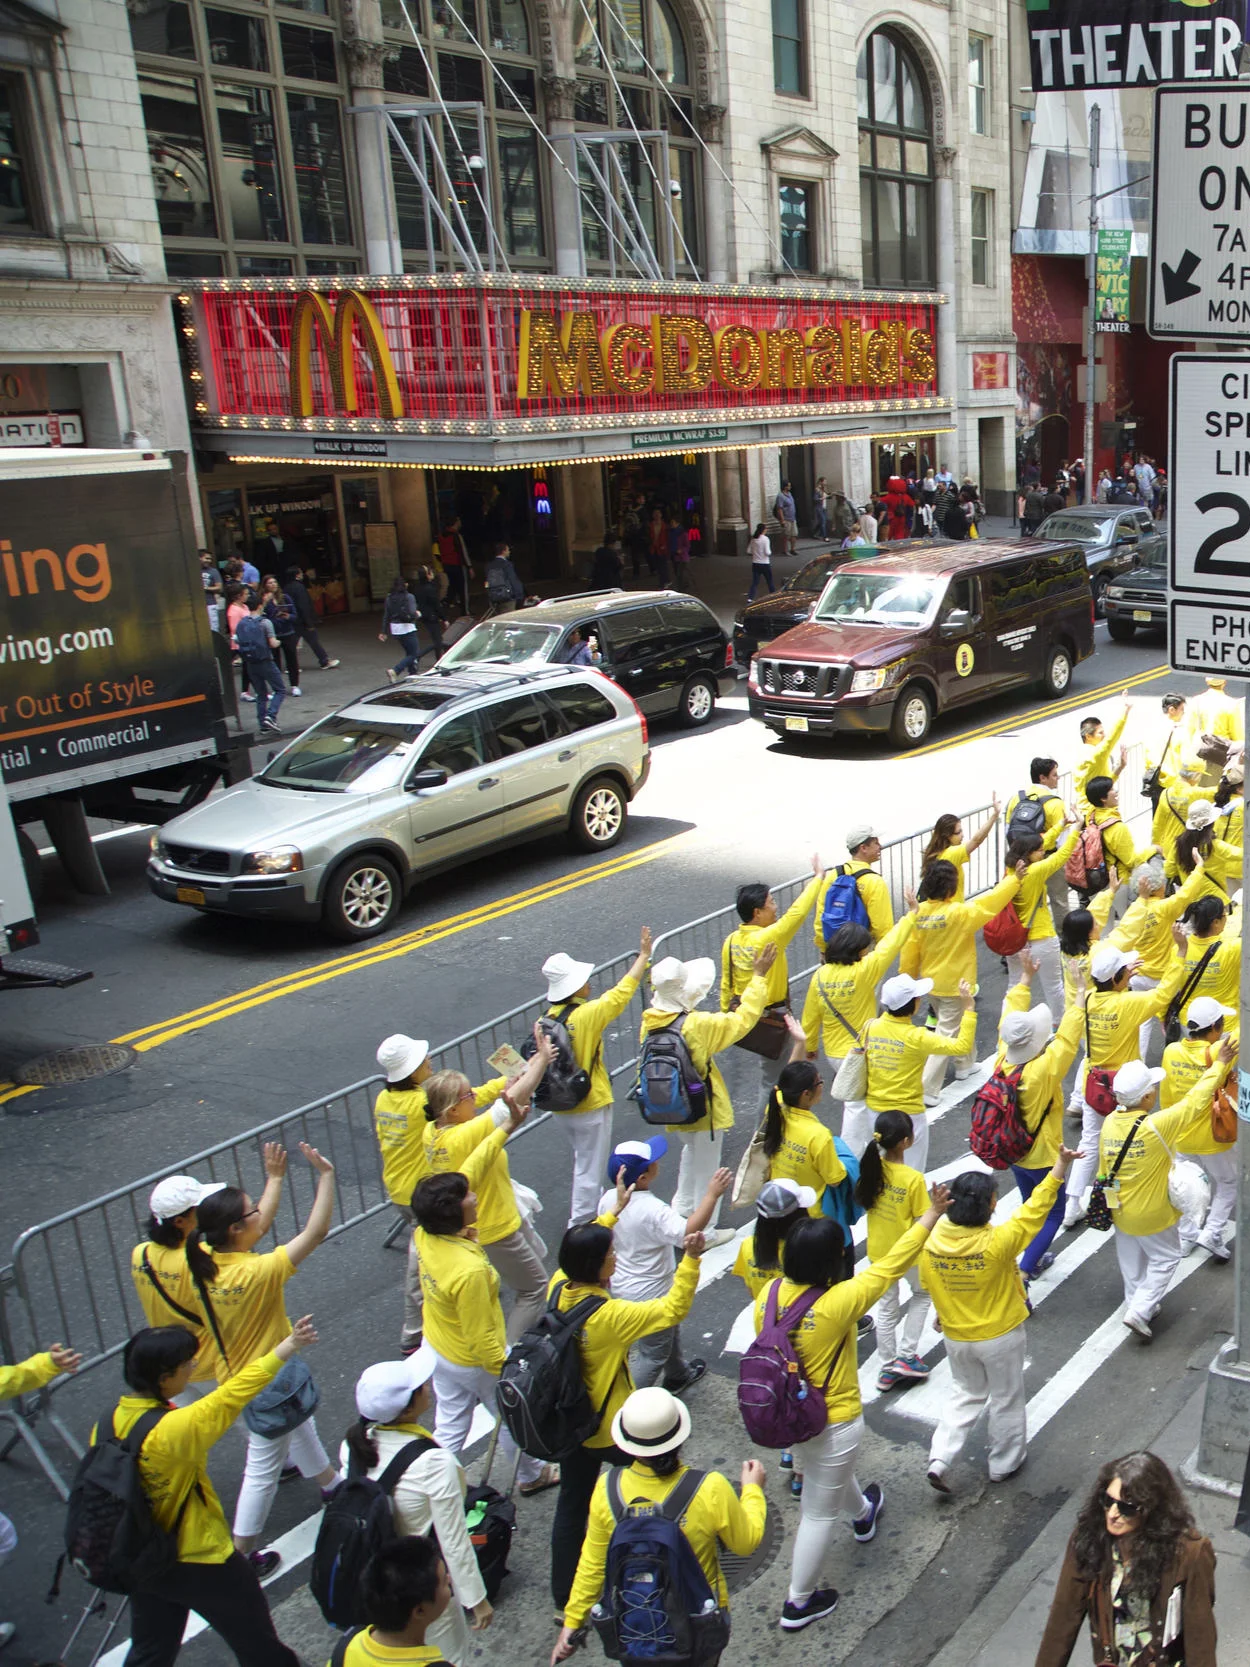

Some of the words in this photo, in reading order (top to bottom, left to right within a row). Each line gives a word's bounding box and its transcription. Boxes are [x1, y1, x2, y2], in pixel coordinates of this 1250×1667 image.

[1031, 17, 1242, 87] THEATER
[1097, 256, 1123, 272] NEW
[1096, 296, 1129, 313] TRY
[1096, 322, 1131, 333] THEATER
[517, 308, 937, 399] McDonald's
[634, 432, 671, 444] PREMIUM
[672, 430, 707, 441] MCWRAP
[708, 428, 727, 438] $3.99
[318, 441, 340, 451] WALK
[341, 442, 353, 451] UP
[353, 443, 386, 453] WINDOW
[16, 694, 63, 720] Out
[69, 682, 93, 710] of
[99, 673, 156, 707] Style
[57, 720, 150, 758] Commercial
